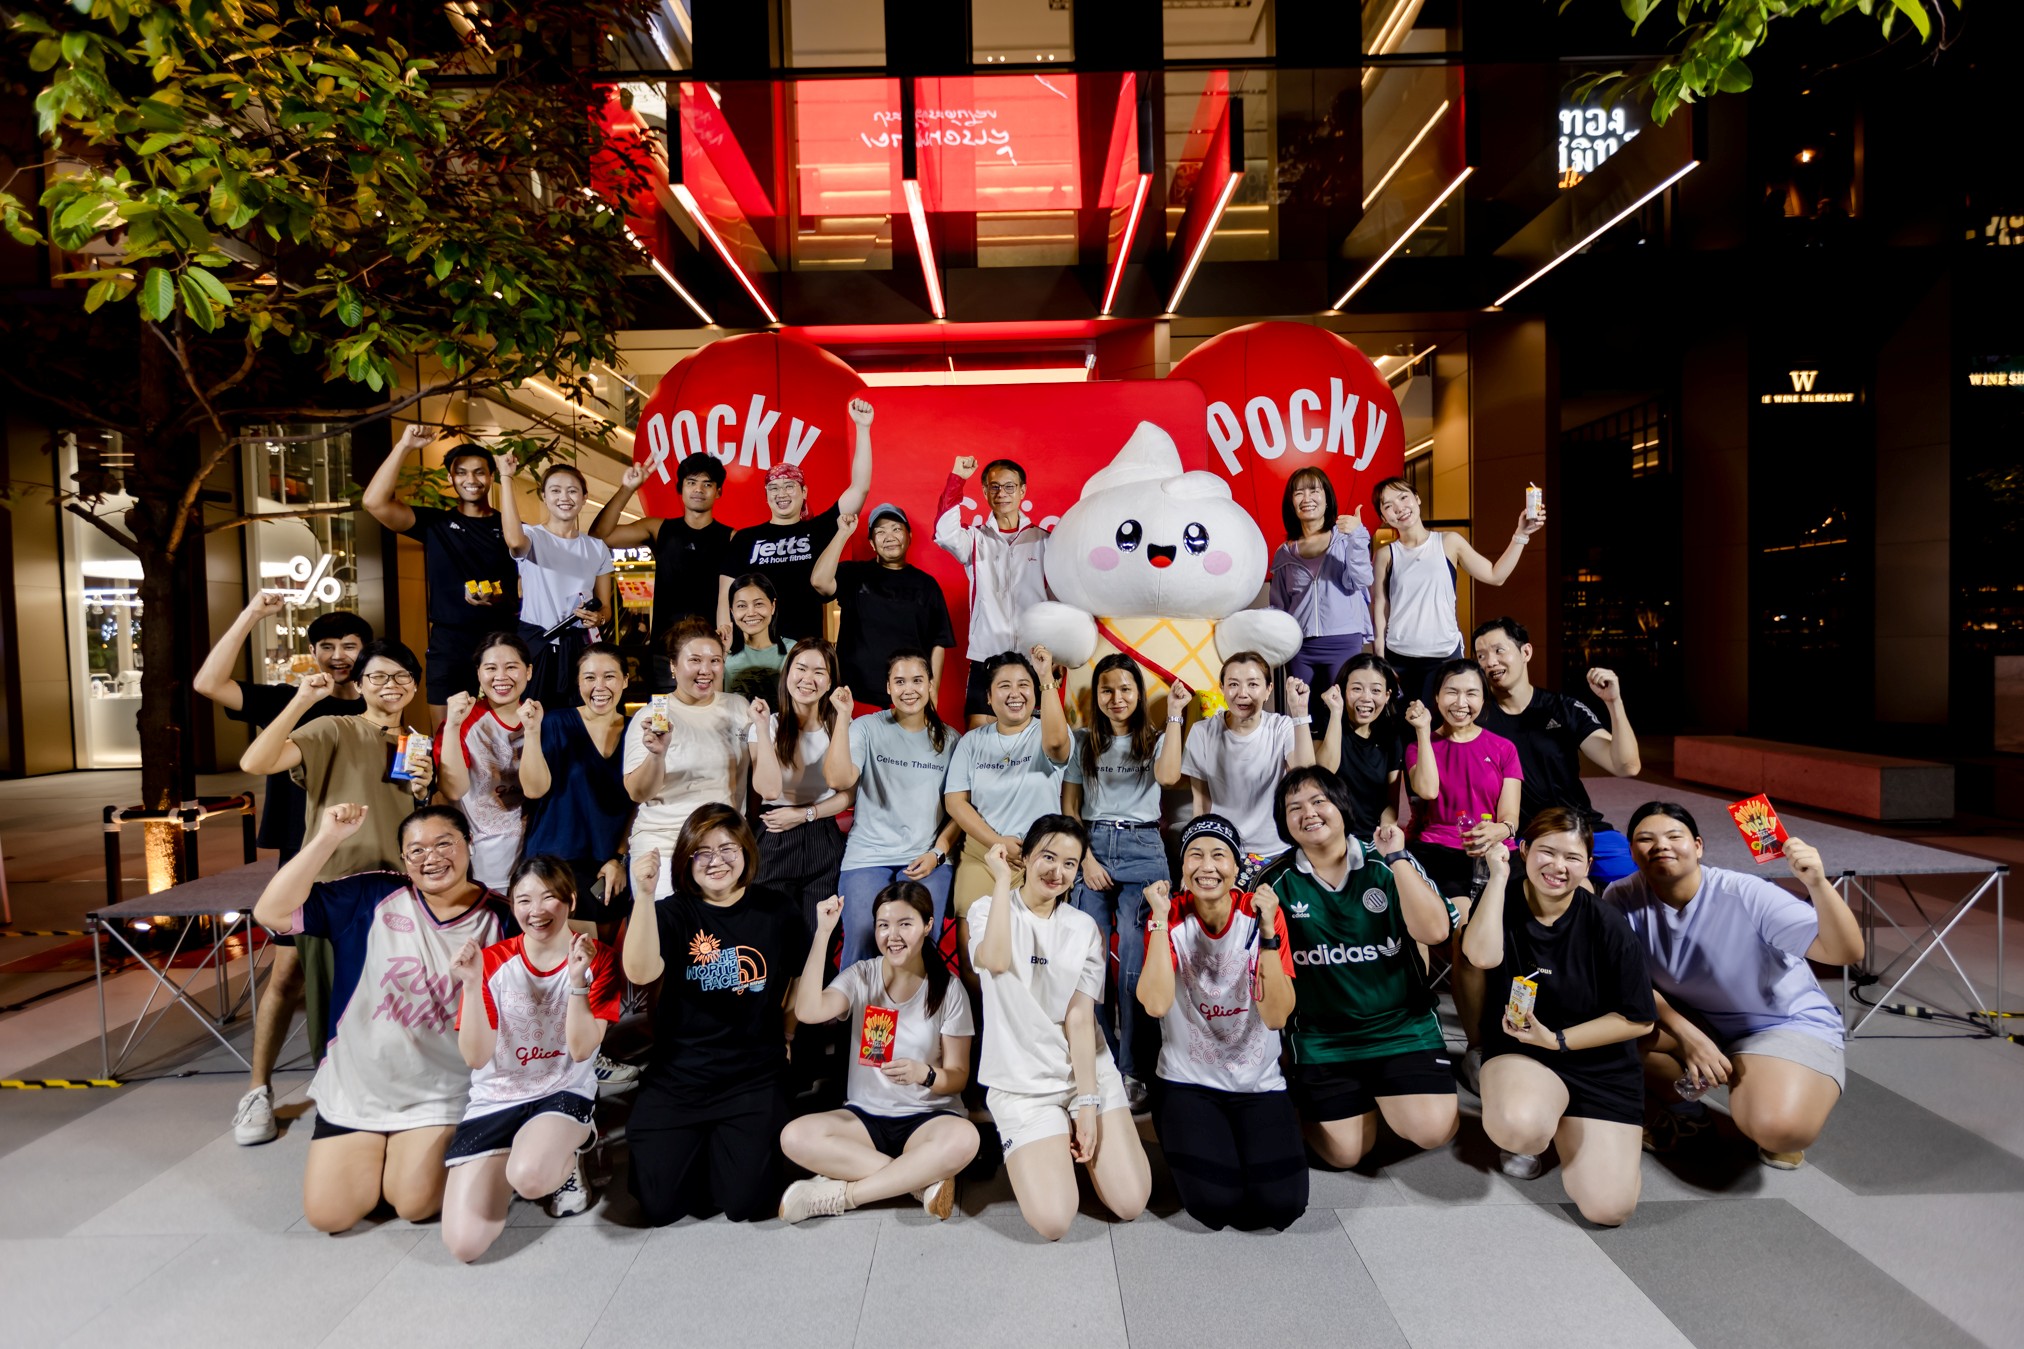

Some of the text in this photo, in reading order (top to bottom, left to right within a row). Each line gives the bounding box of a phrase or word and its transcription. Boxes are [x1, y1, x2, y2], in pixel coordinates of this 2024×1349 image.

[1789, 370, 1818, 392] W
[1968, 372, 2008, 387] WINE
[1773, 394, 1800, 403] WINE
[1801, 393, 1855, 403] MERCHANT
[750, 535, 811, 565] jetts
[759, 553, 812, 565] 24 hour fitness
[876, 754, 945, 772] Celeste Thailand
[707, 947, 737, 964] THE
[1292, 942, 1379, 966] adidas
[686, 959, 739, 980] NORTH
[701, 974, 741, 992] FACE
[1200, 1002, 1248, 1021] Glico
[515, 1046, 566, 1066] Glico
